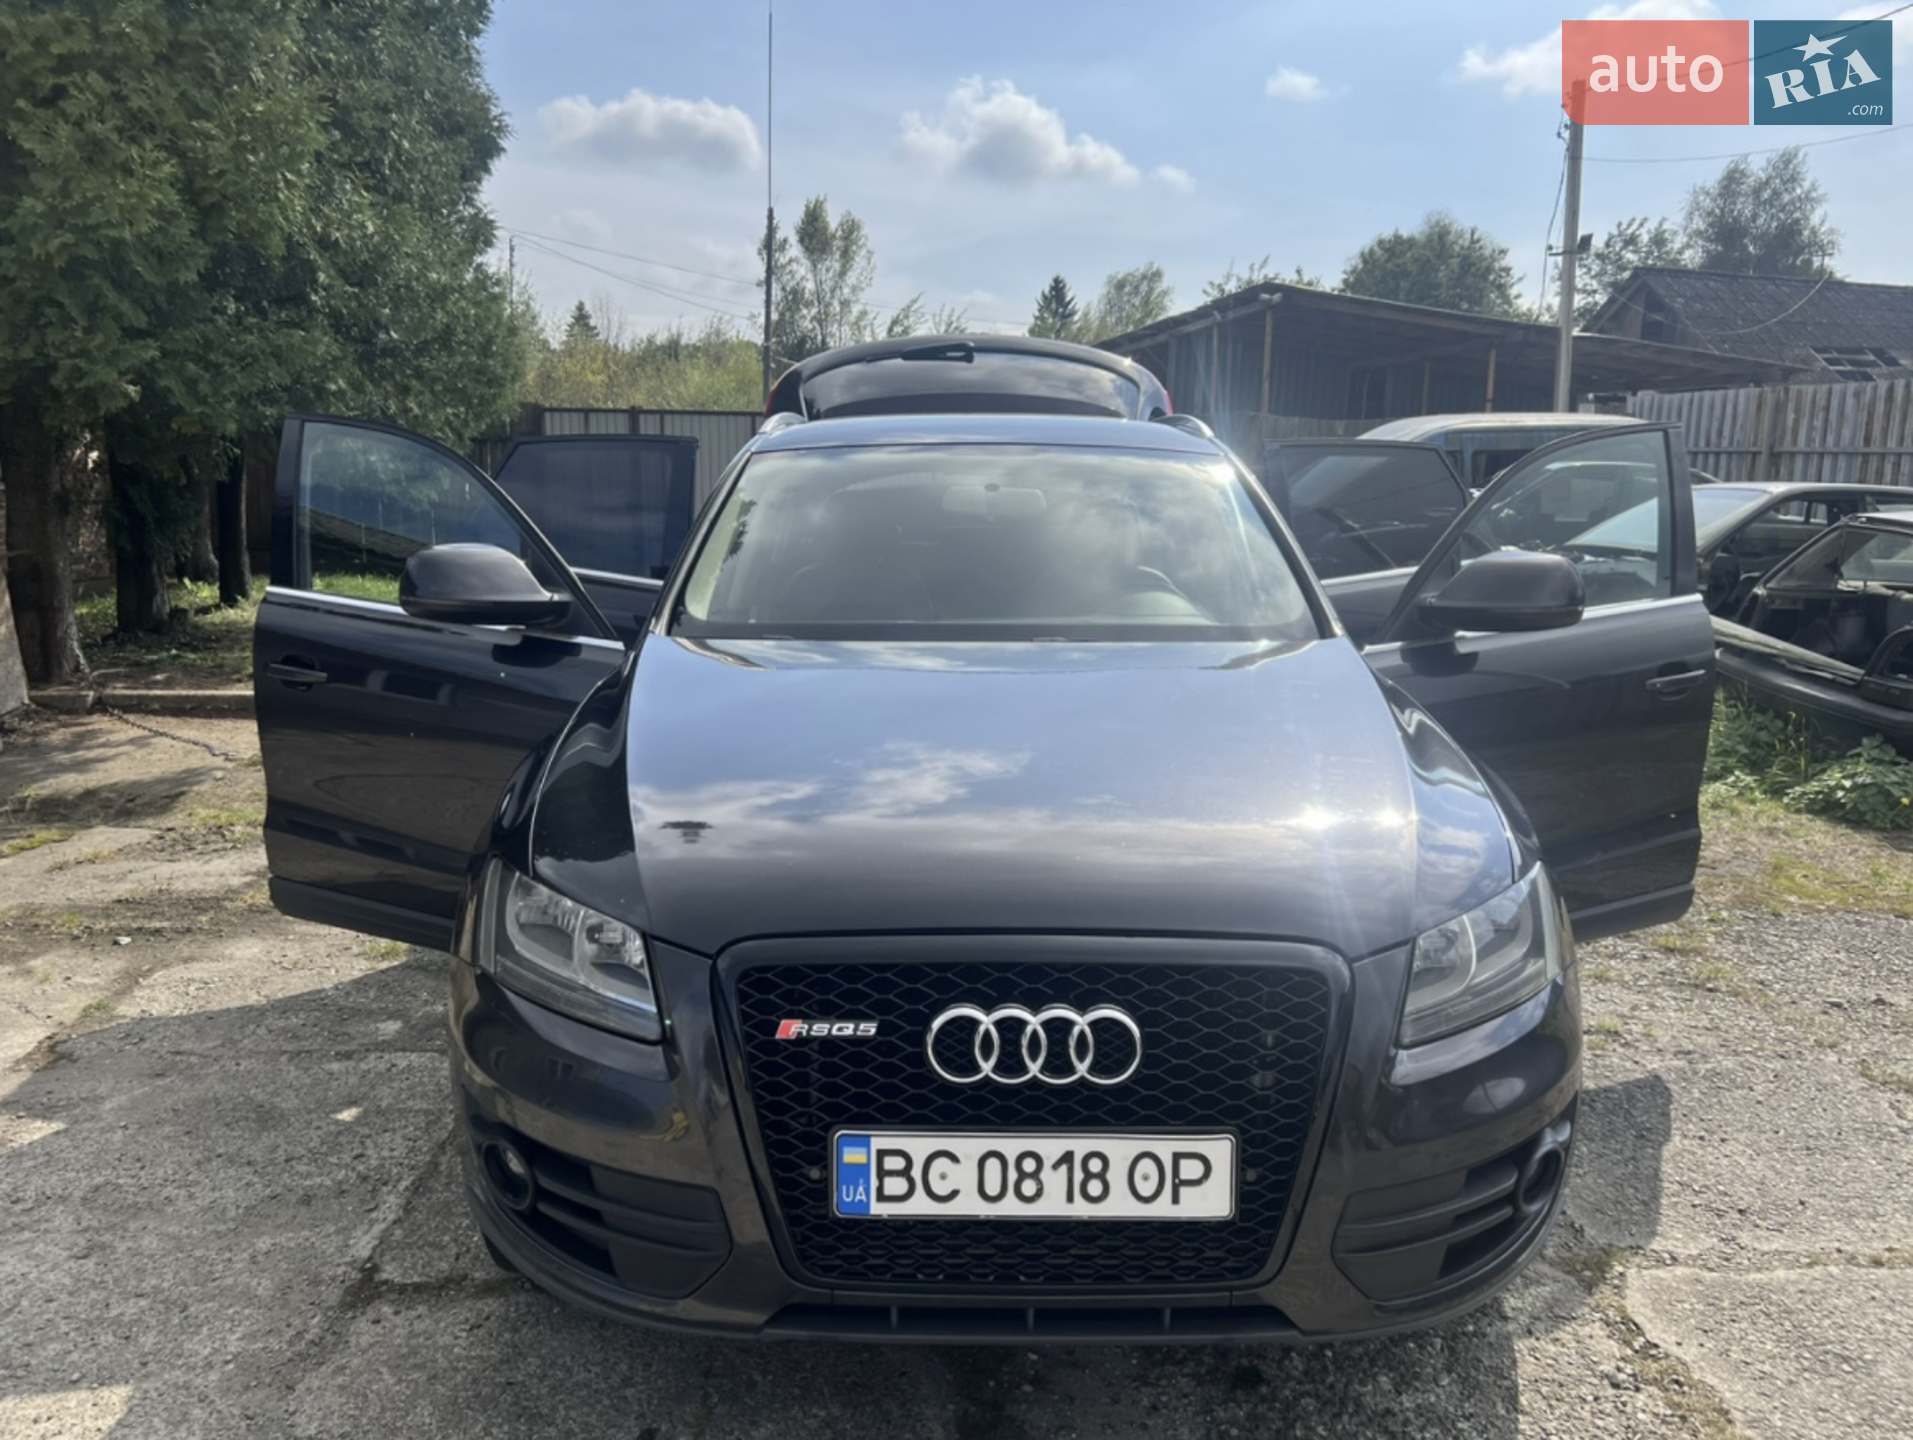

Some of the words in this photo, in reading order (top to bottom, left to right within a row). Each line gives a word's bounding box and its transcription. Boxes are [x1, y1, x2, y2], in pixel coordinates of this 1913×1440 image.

[787, 1021, 879, 1037] RSQ5
[876, 1148, 961, 1204] BC
[976, 1150, 1111, 1205] 0818
[1127, 1151, 1213, 1206] OP
[842, 1185, 867, 1203] UA
